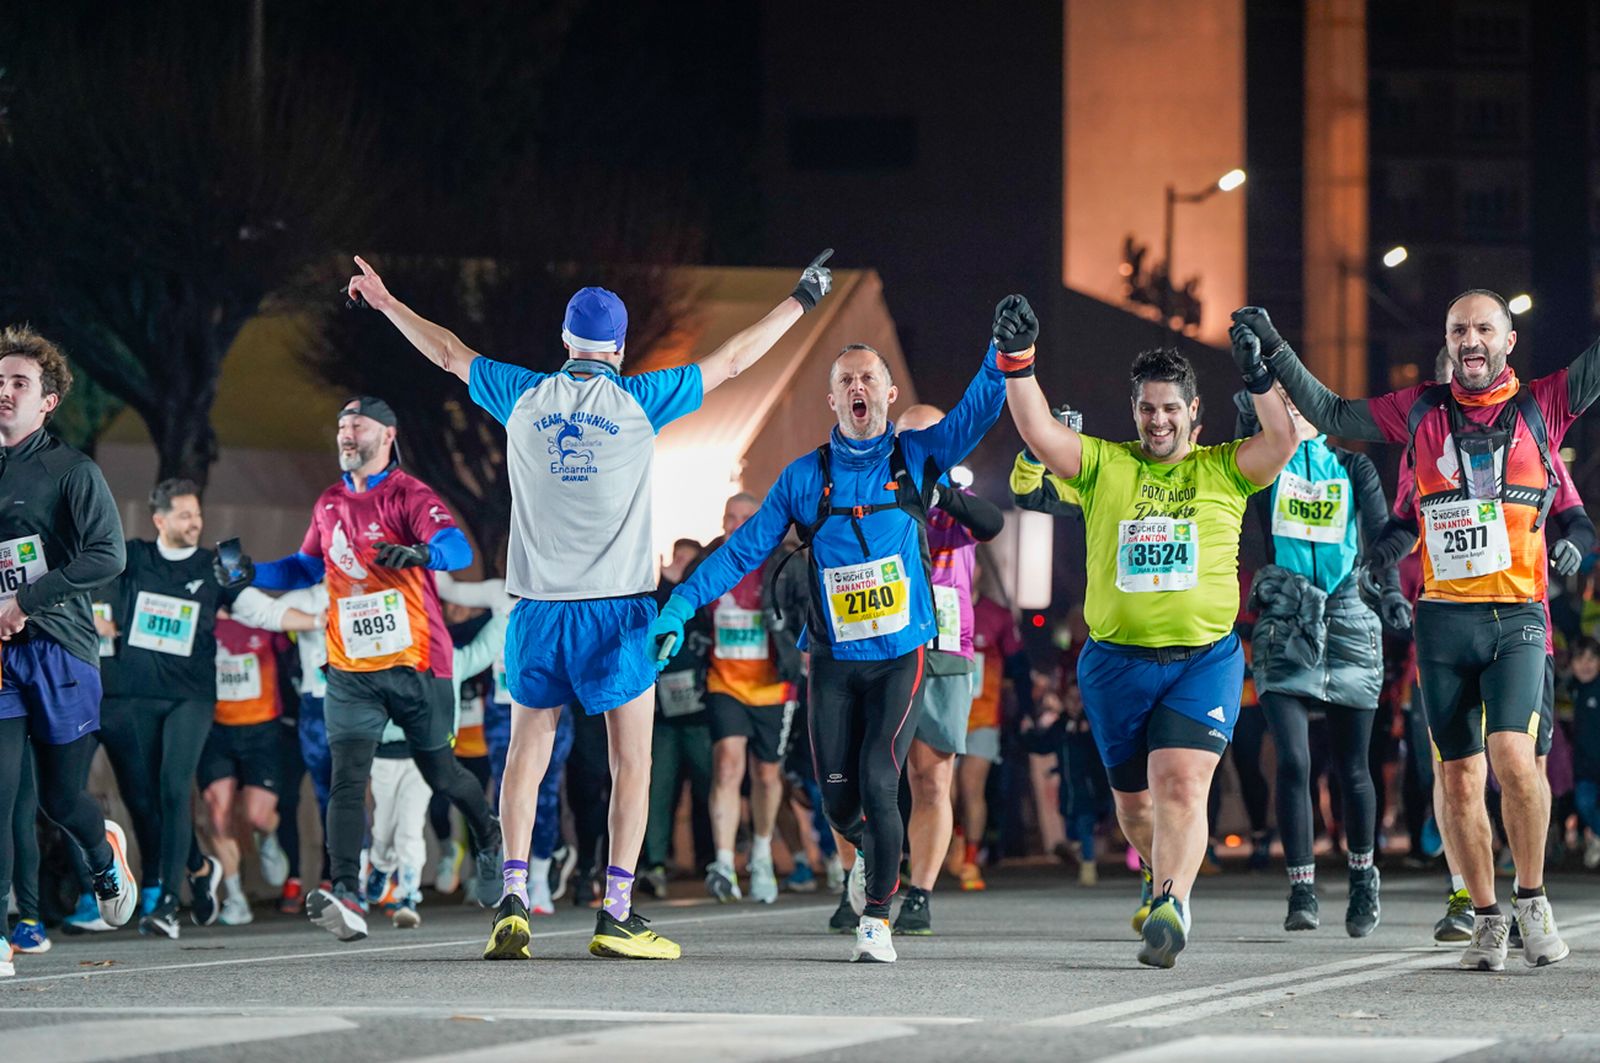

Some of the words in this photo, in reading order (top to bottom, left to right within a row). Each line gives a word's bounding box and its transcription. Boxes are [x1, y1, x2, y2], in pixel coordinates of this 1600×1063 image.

[533, 412, 562, 433] TEAM
[570, 411, 620, 436] RUNNING
[550, 461, 598, 475] Encarnita
[1142, 484, 1165, 502] POZO
[1289, 498, 1334, 520] 6632
[1439, 509, 1460, 520] NOCHE
[1461, 508, 1470, 516] DE
[1157, 524, 1167, 533] DE
[1433, 520, 1446, 531] SAN
[1443, 525, 1488, 554] 2677
[843, 571, 864, 582] NOCHE
[836, 582, 850, 593] SAN
[845, 585, 895, 615] 2740
[353, 614, 396, 636] 4893
